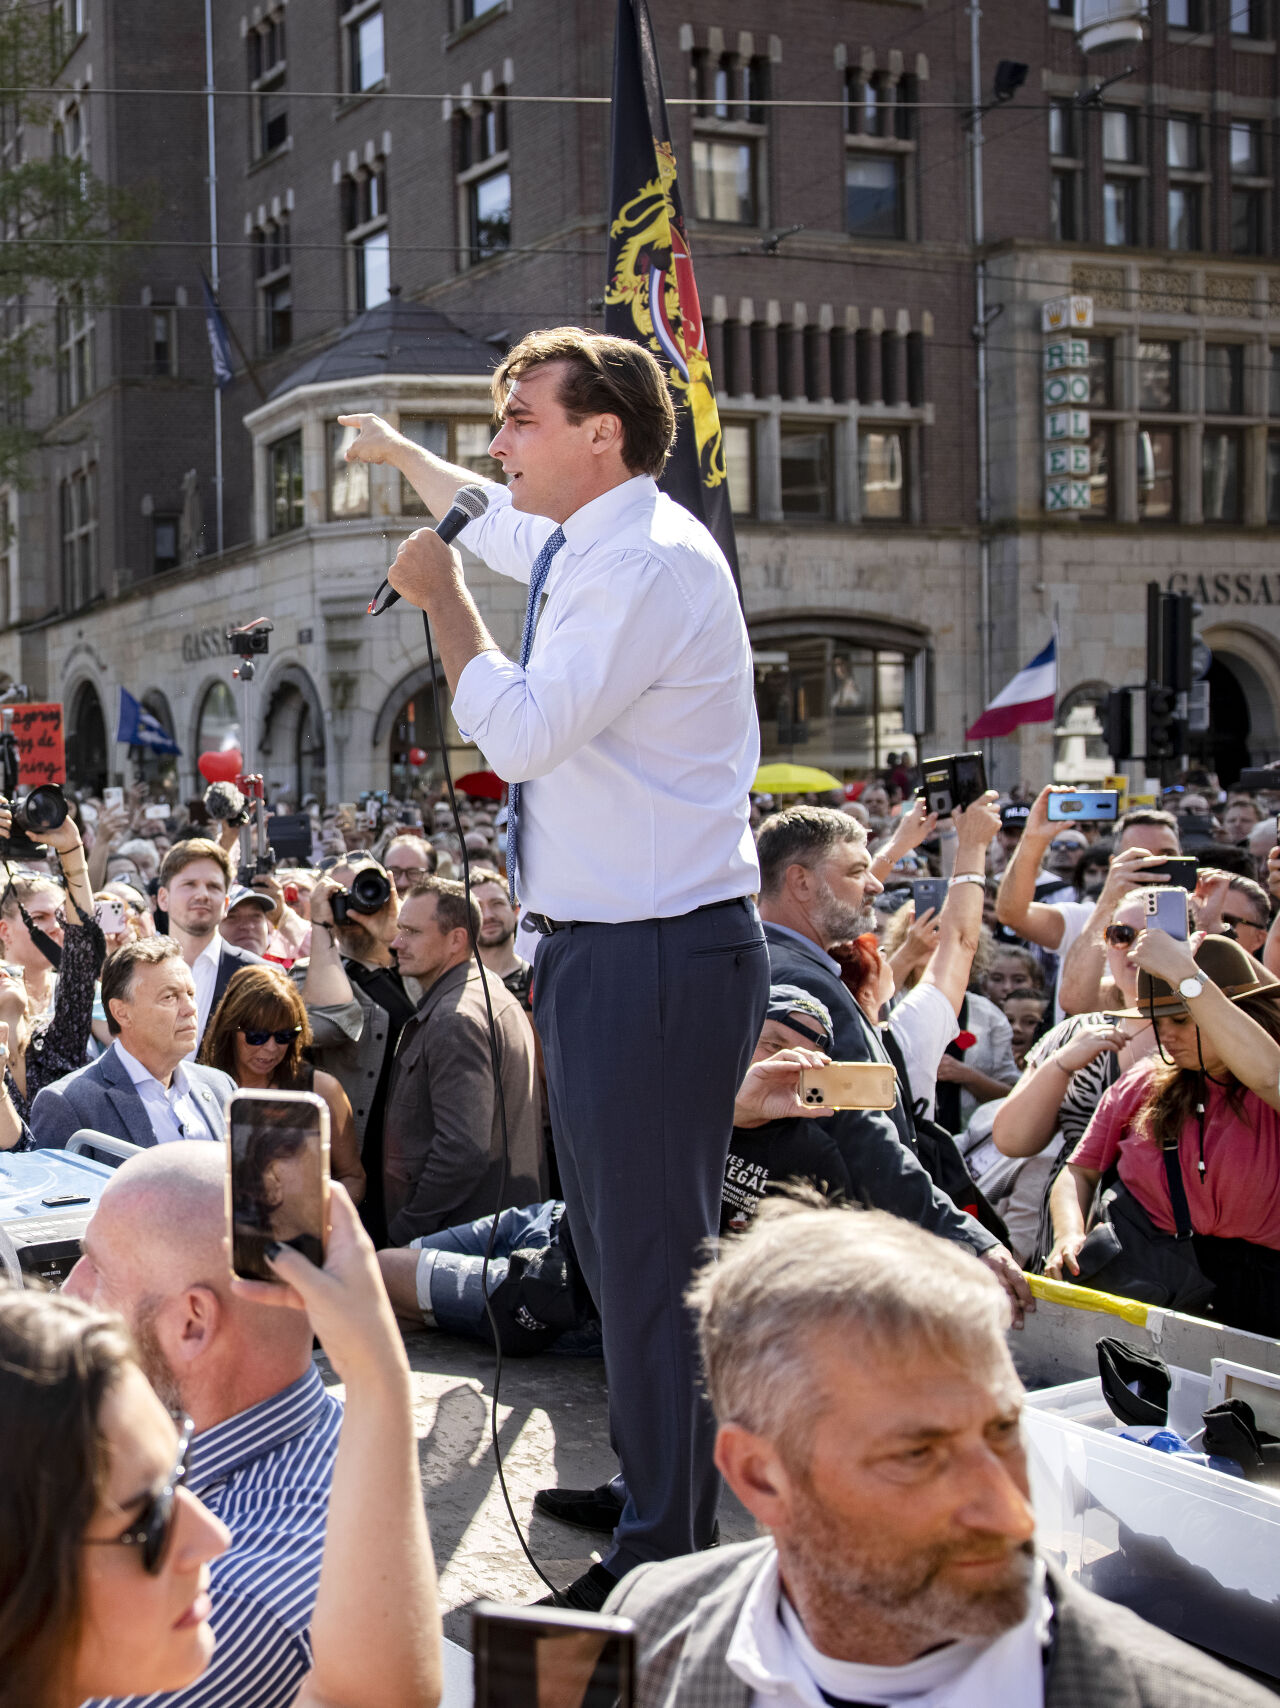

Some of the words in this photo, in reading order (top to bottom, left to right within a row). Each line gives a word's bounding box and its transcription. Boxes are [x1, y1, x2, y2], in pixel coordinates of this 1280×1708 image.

[1047, 343, 1068, 508] ROLEX
[1070, 340, 1090, 508] ROLEX
[1166, 571, 1280, 605] GASSA
[182, 620, 243, 663] GASSA
[726, 1165, 767, 1194] EGAL
[746, 1162, 769, 1179] ARE
[724, 1182, 746, 1196] NDANCE
